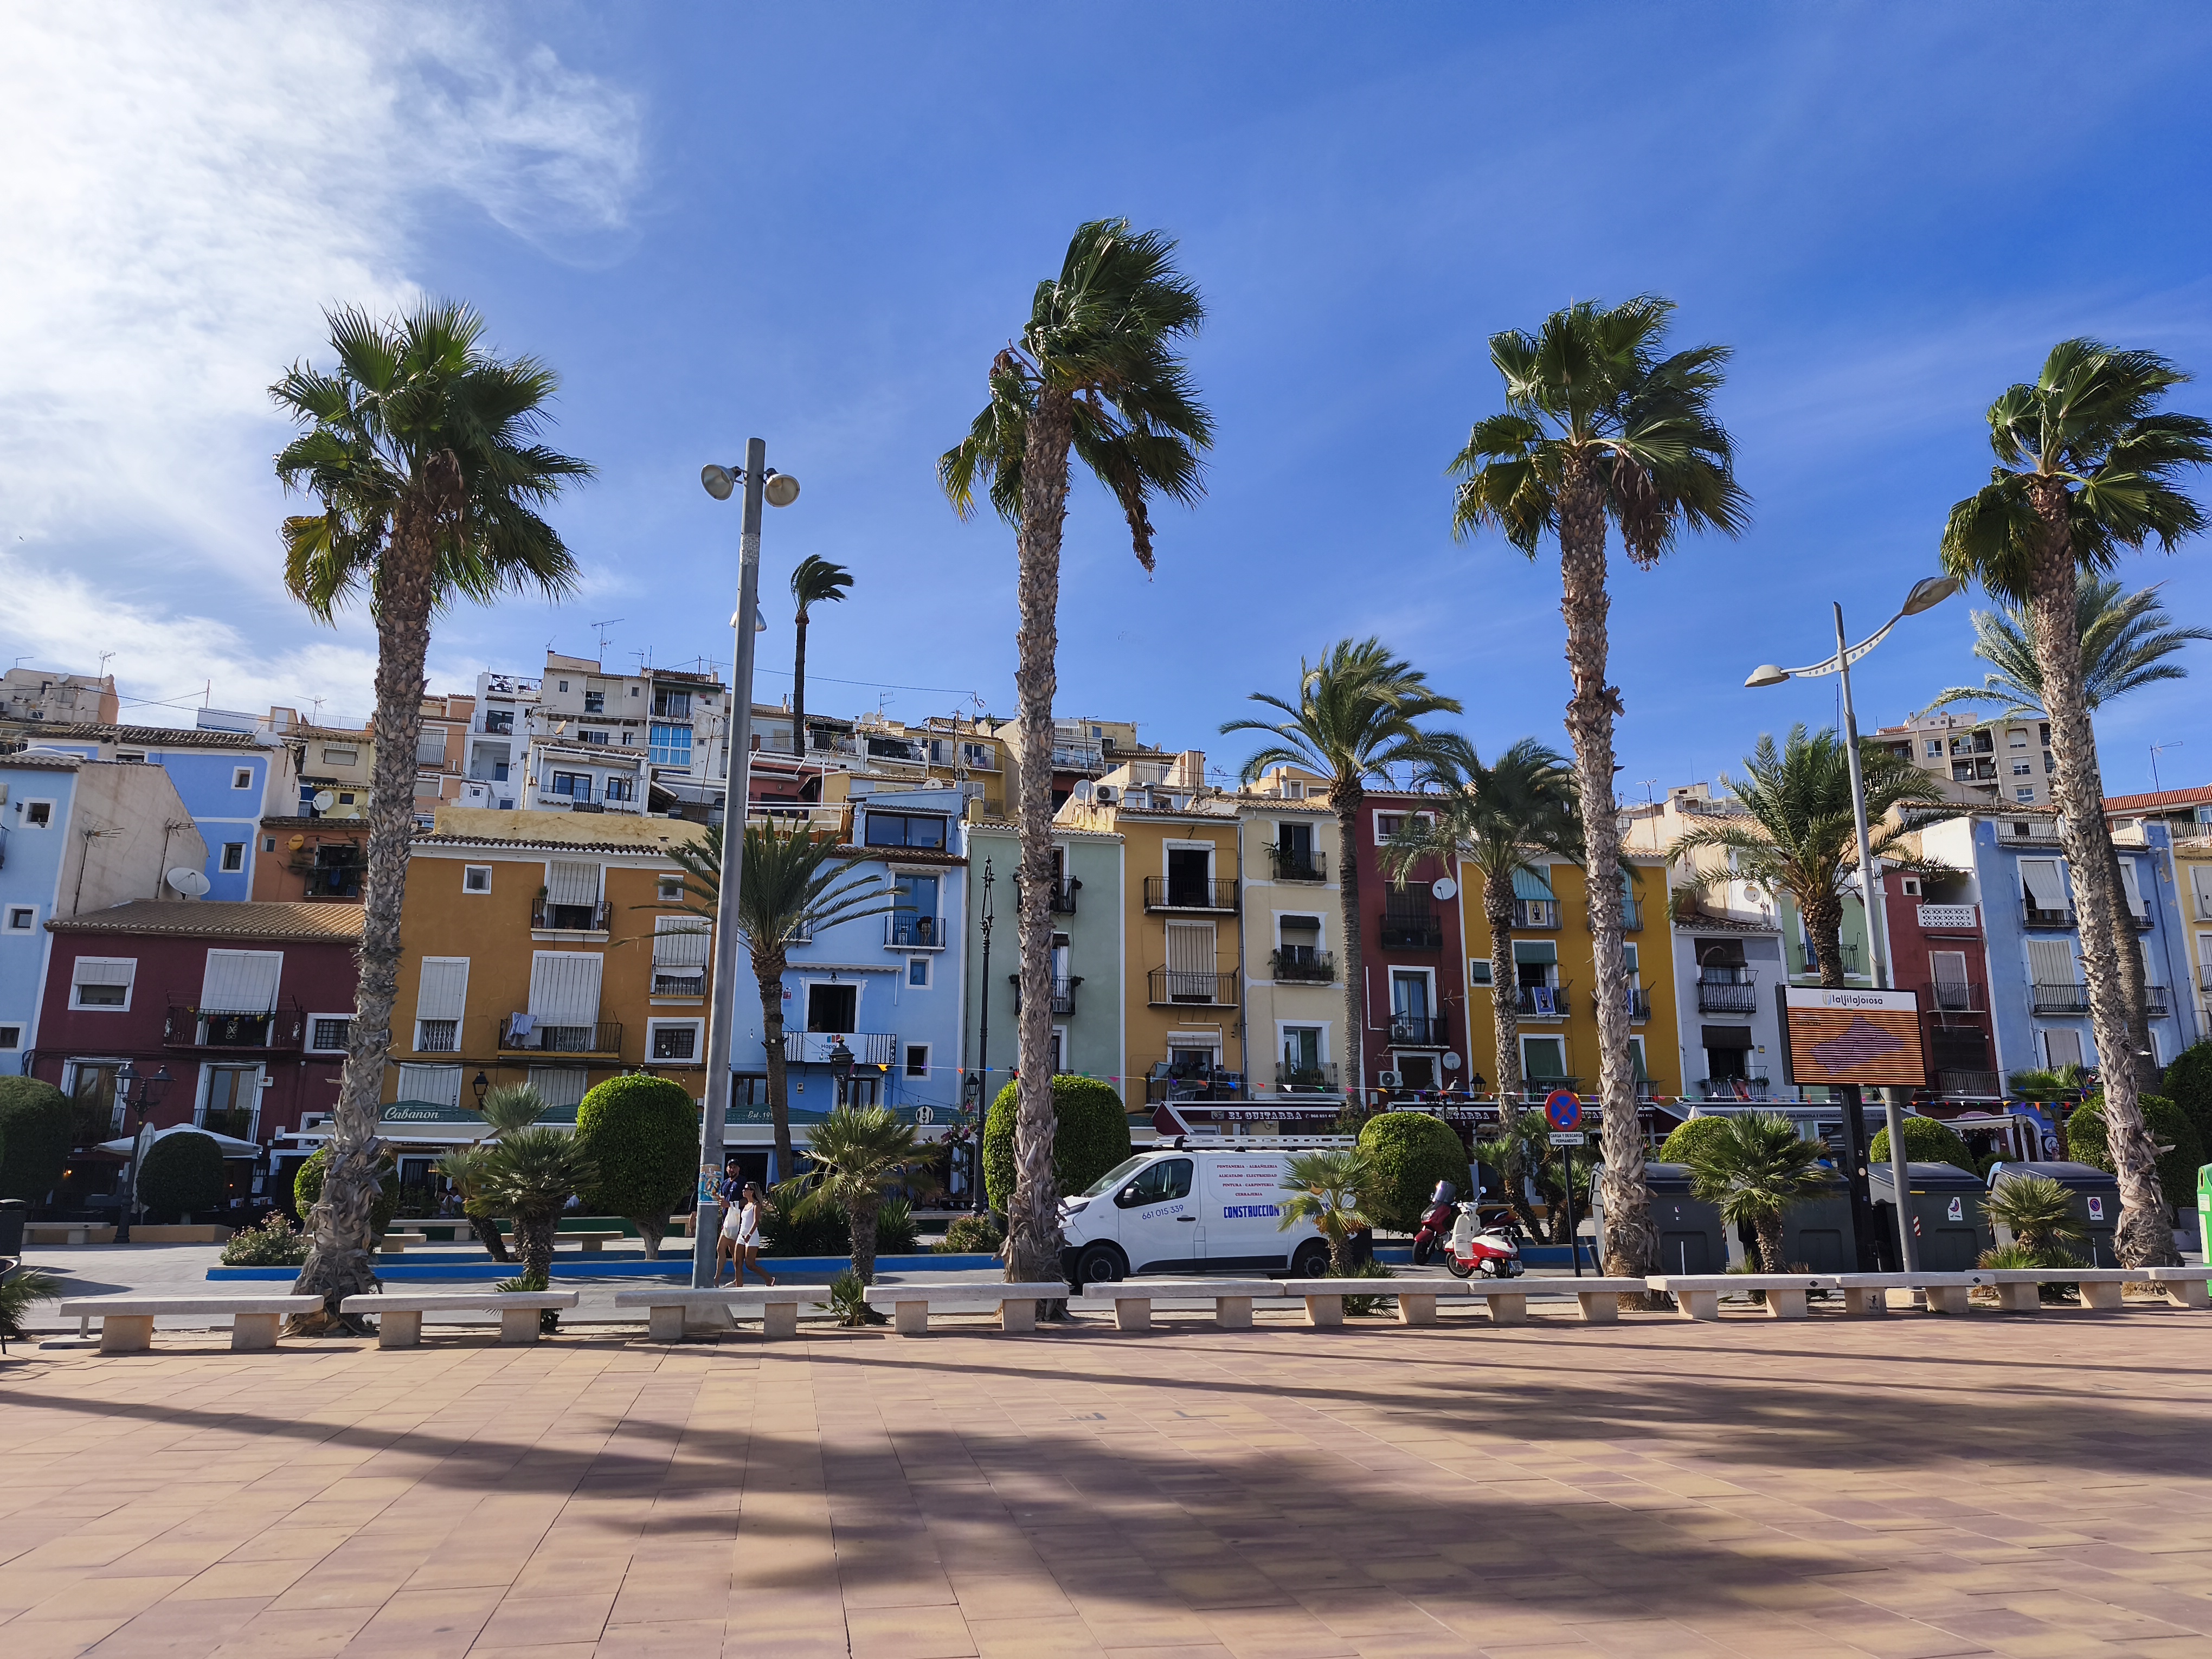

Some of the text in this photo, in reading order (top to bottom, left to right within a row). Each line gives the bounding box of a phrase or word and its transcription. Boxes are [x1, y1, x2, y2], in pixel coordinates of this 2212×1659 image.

[384, 1107, 440, 1120] Cabanon
[1228, 1111, 1242, 1120] EL
[1245, 1111, 1302, 1120] GUITARRA
[1142, 1204, 1184, 1220] 661 015 339
[1223, 1204, 1280, 1219] CONSTRUCCION
